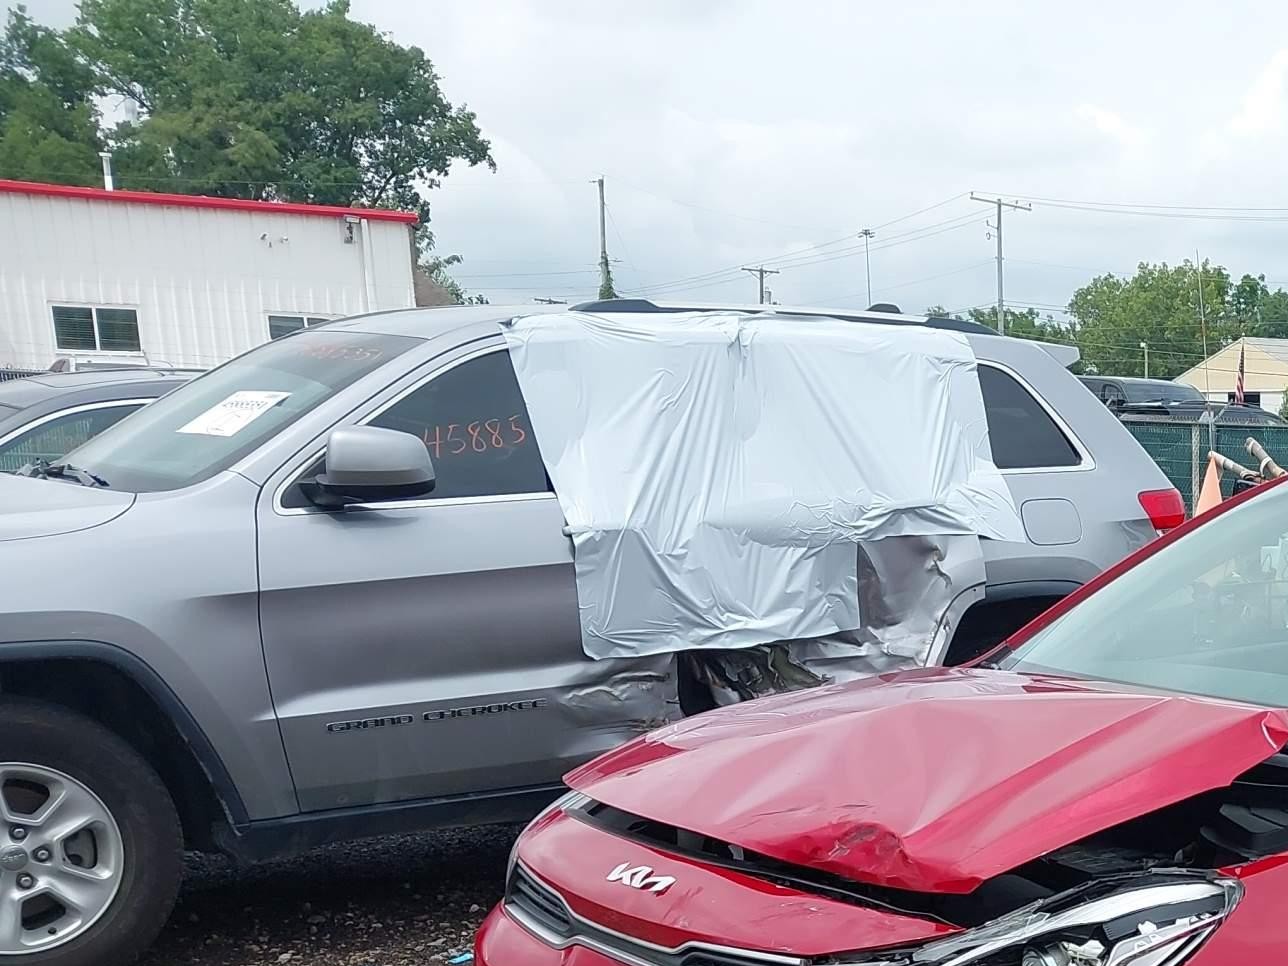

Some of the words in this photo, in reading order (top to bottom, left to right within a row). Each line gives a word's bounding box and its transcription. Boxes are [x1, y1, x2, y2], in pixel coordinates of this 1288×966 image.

[326, 714, 414, 732] GRAND
[423, 698, 547, 721] CHEROKEE
[606, 861, 677, 892] KIA
